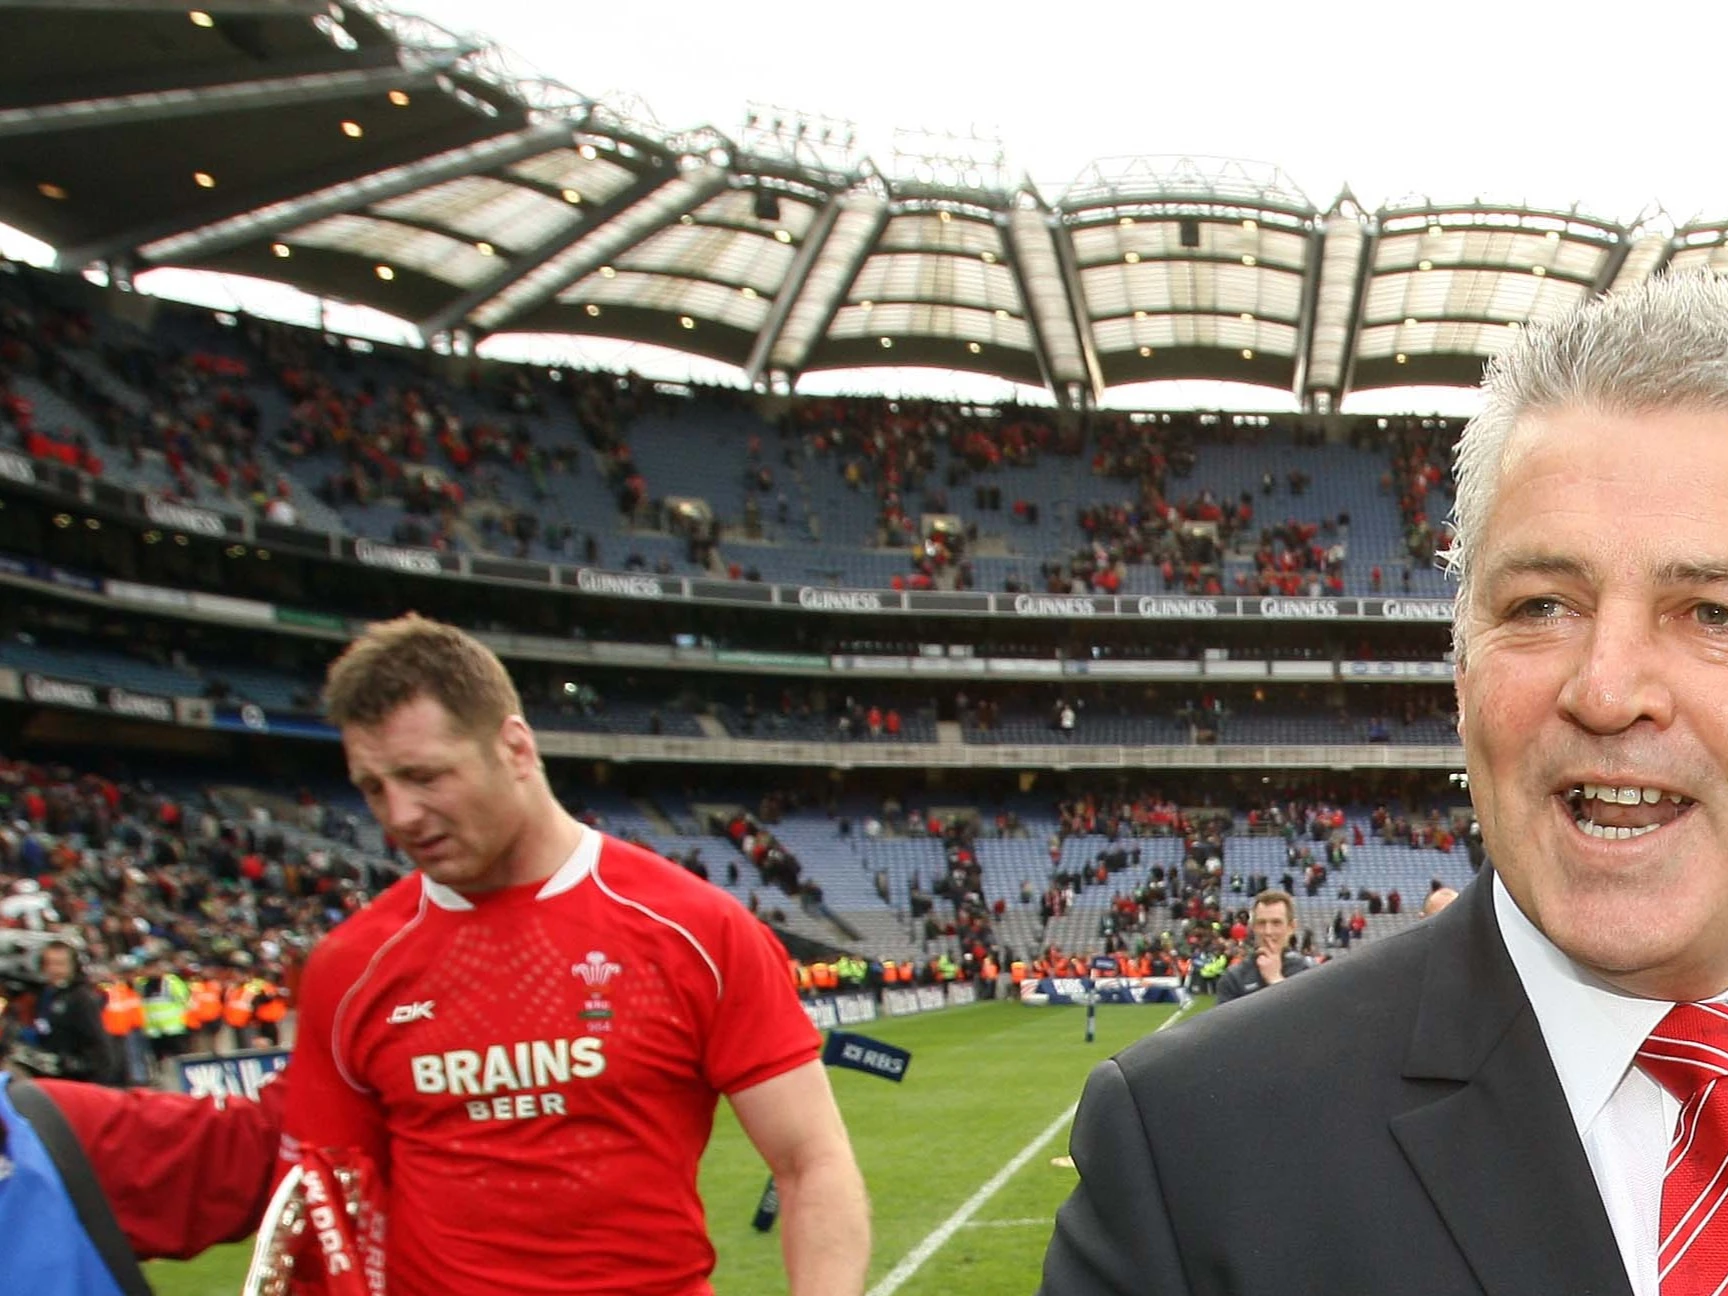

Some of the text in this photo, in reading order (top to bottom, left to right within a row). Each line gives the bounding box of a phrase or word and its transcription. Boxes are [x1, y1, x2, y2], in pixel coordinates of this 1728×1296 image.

[577, 567, 663, 597] GUINNESS
[799, 586, 881, 610] GUINNESS
[1014, 593, 1095, 617] GUINNESS
[1138, 595, 1218, 618] GUINNESS
[1260, 596, 1339, 618] GUINNESS
[411, 1036, 606, 1096] BRAINS
[466, 1092, 567, 1121] BEER
